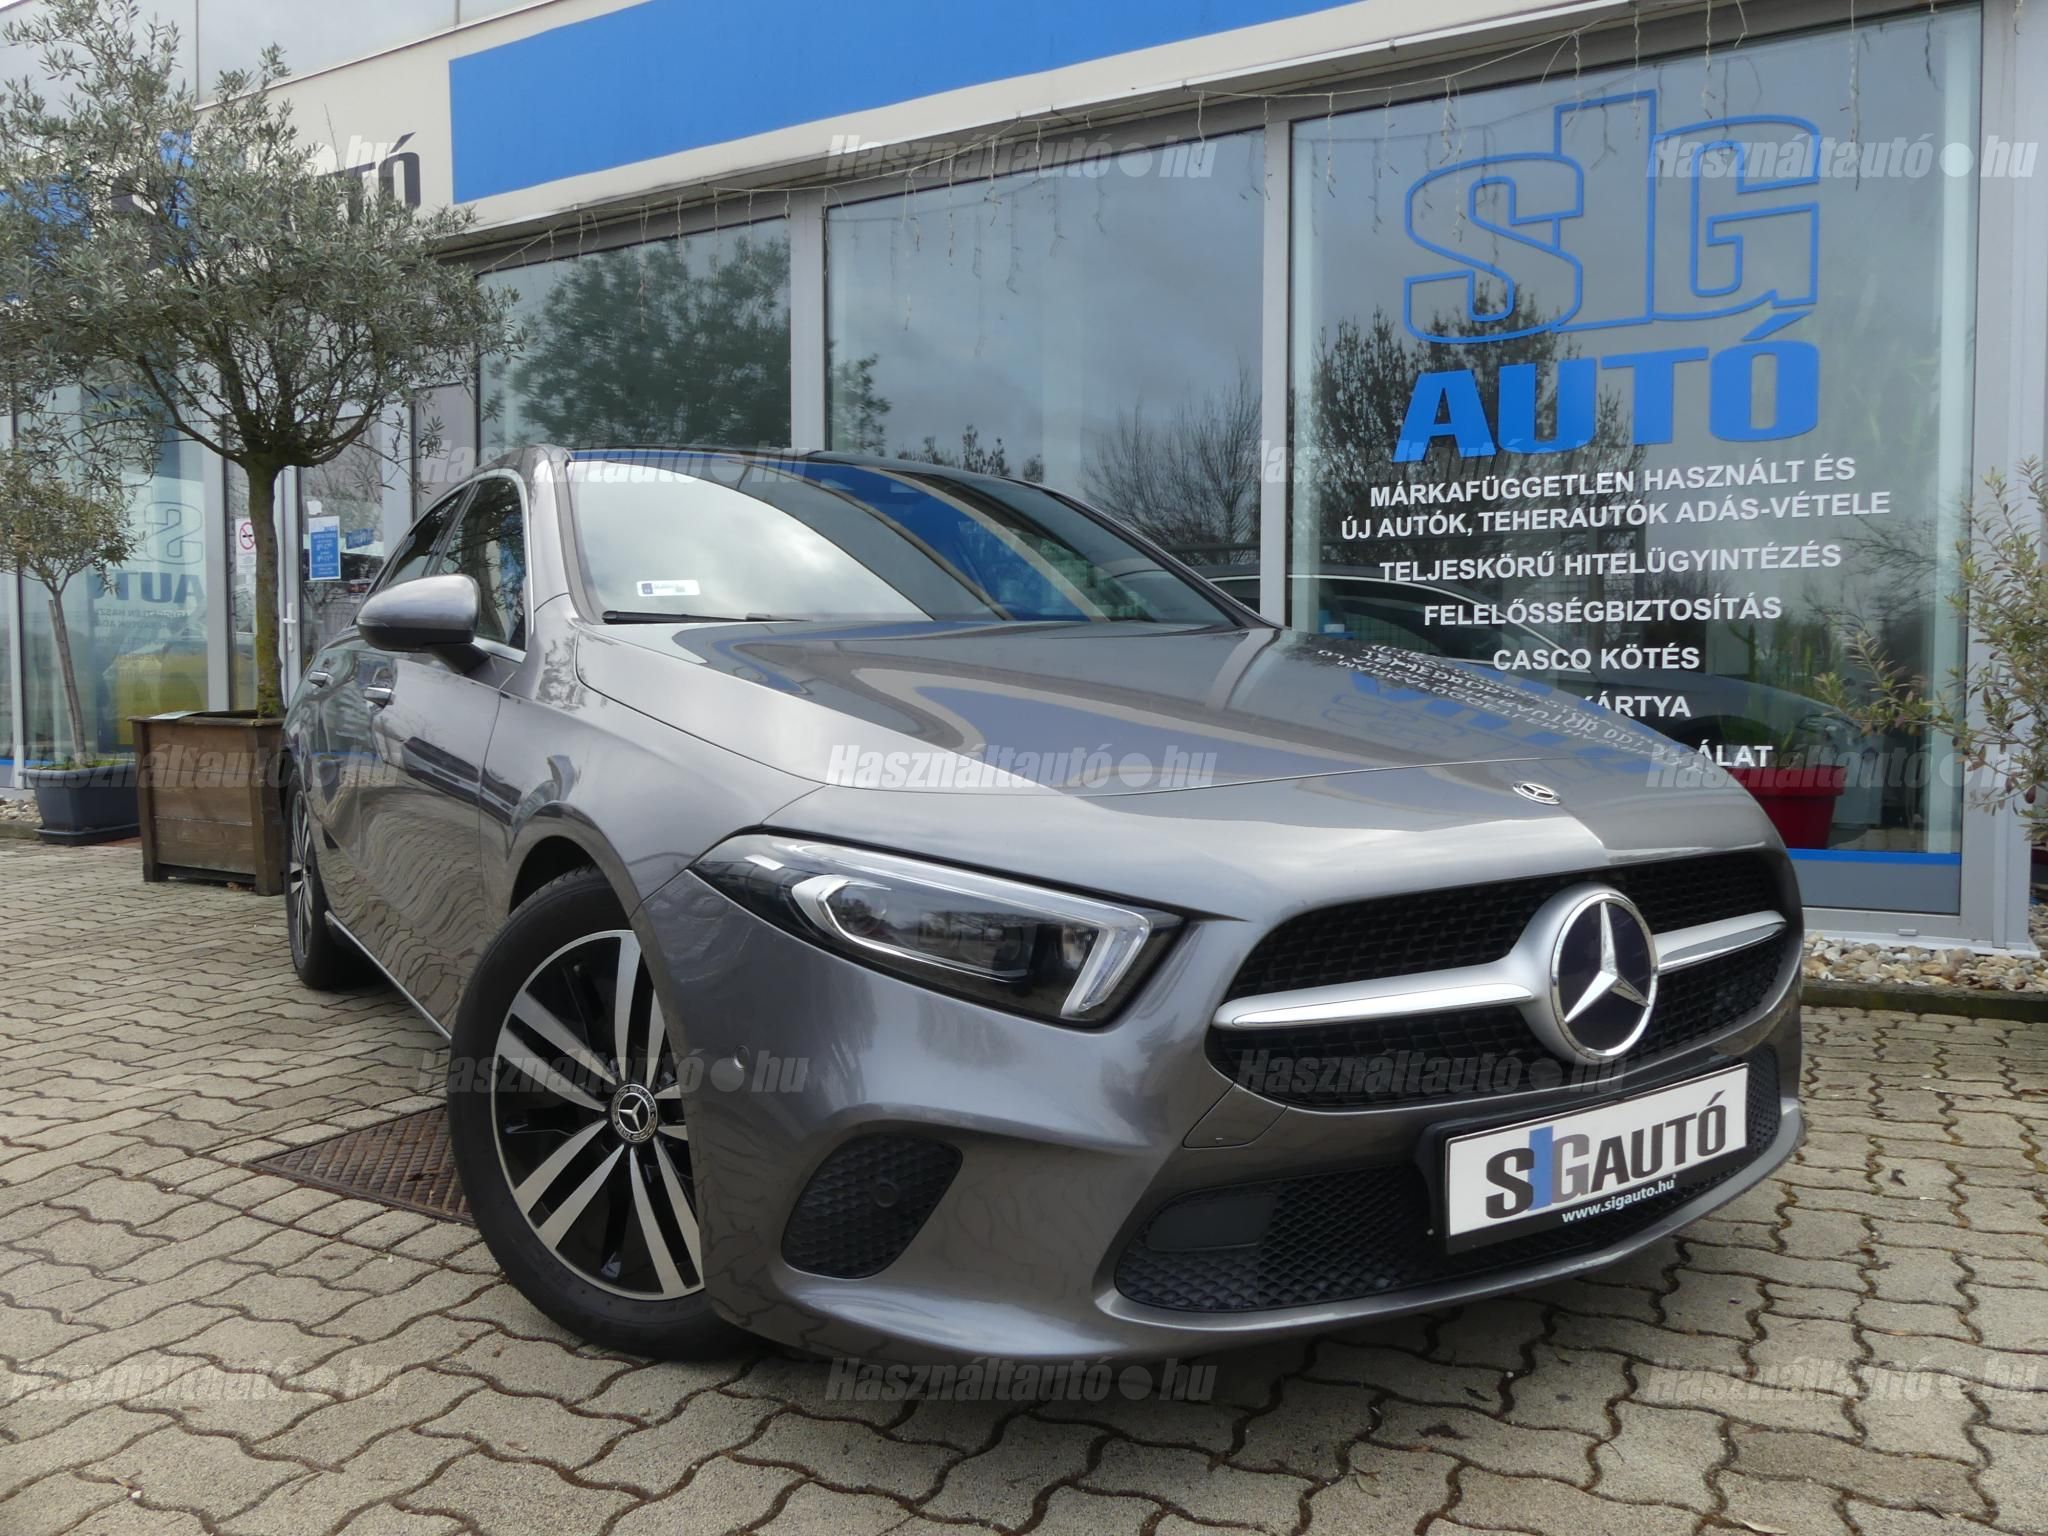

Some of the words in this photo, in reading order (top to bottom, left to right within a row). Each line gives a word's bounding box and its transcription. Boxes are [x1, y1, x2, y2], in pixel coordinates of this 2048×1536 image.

[1394, 311, 1819, 465] AUTÓ
[1370, 471, 1634, 507] MÁRKAFÜGGETLEN
[1643, 461, 1804, 493] HASZNÁLT
[1813, 457, 1856, 483] ÉS
[1341, 519, 1373, 540] ÚJ
[1378, 510, 1474, 538] AUTÓK,
[1477, 501, 1667, 533] TEHERAUTÓK
[1675, 491, 1891, 524] ADÁS-VÉTELE
[1380, 550, 1556, 583] TELJESKÖRŰ
[1564, 544, 1842, 578] HITELÜGYINTÉZÉS
[1424, 596, 1782, 629] FELELŐSSÉGBIZTOSÍTÁS
[1493, 648, 1591, 672] CASCO
[1600, 643, 1700, 671] KÖTÉS
[1585, 695, 1691, 718] ÁRTYA
[1561, 1176, 1675, 1223] www.sigauto.hu
